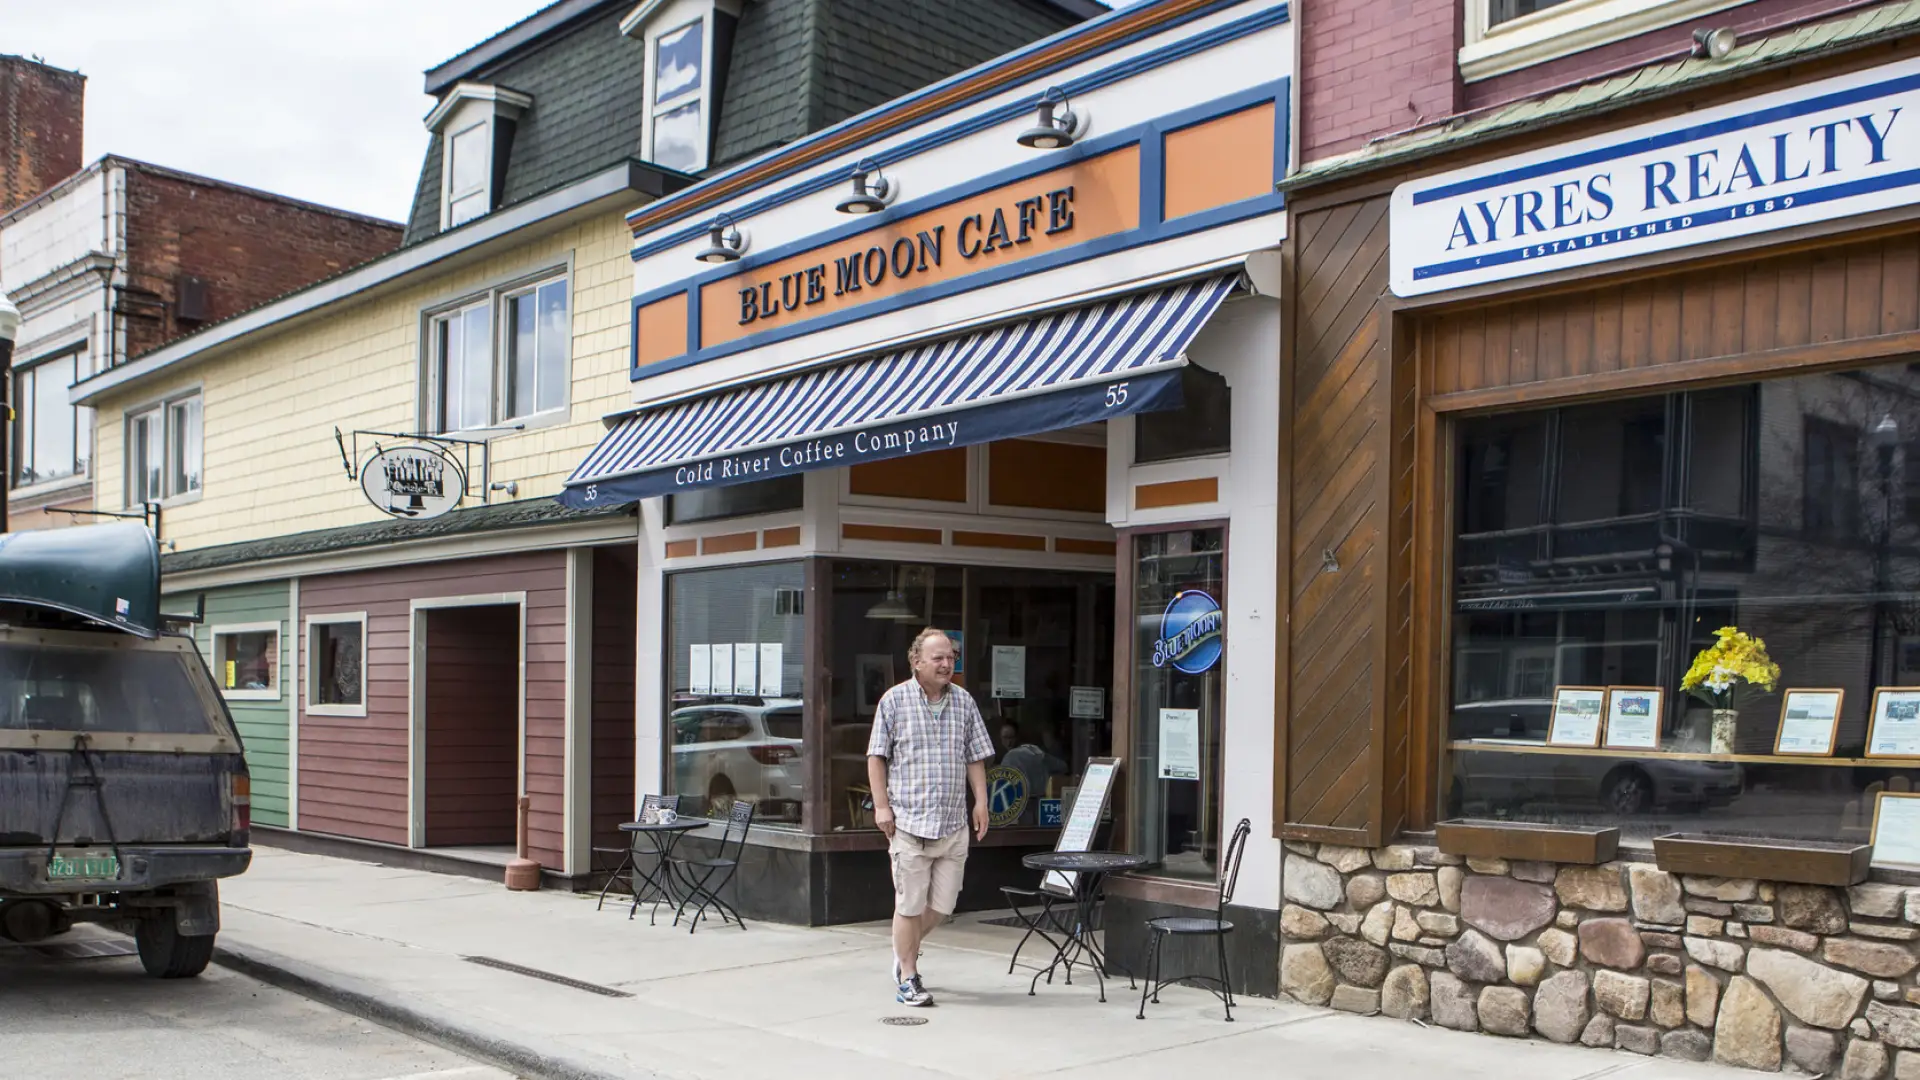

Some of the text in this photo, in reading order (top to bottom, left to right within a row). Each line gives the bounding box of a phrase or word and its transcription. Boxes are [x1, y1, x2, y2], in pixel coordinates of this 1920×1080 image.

[1445, 107, 1904, 251] AYRES REALTY
[737, 185, 1075, 326] BLUE MOON CAFE
[1522, 196, 1796, 259] ESTABLISHED 1889
[1104, 382, 1129, 407] 55
[675, 420, 959, 485] Cold River Coffee Company
[584, 484, 598, 501] 55
